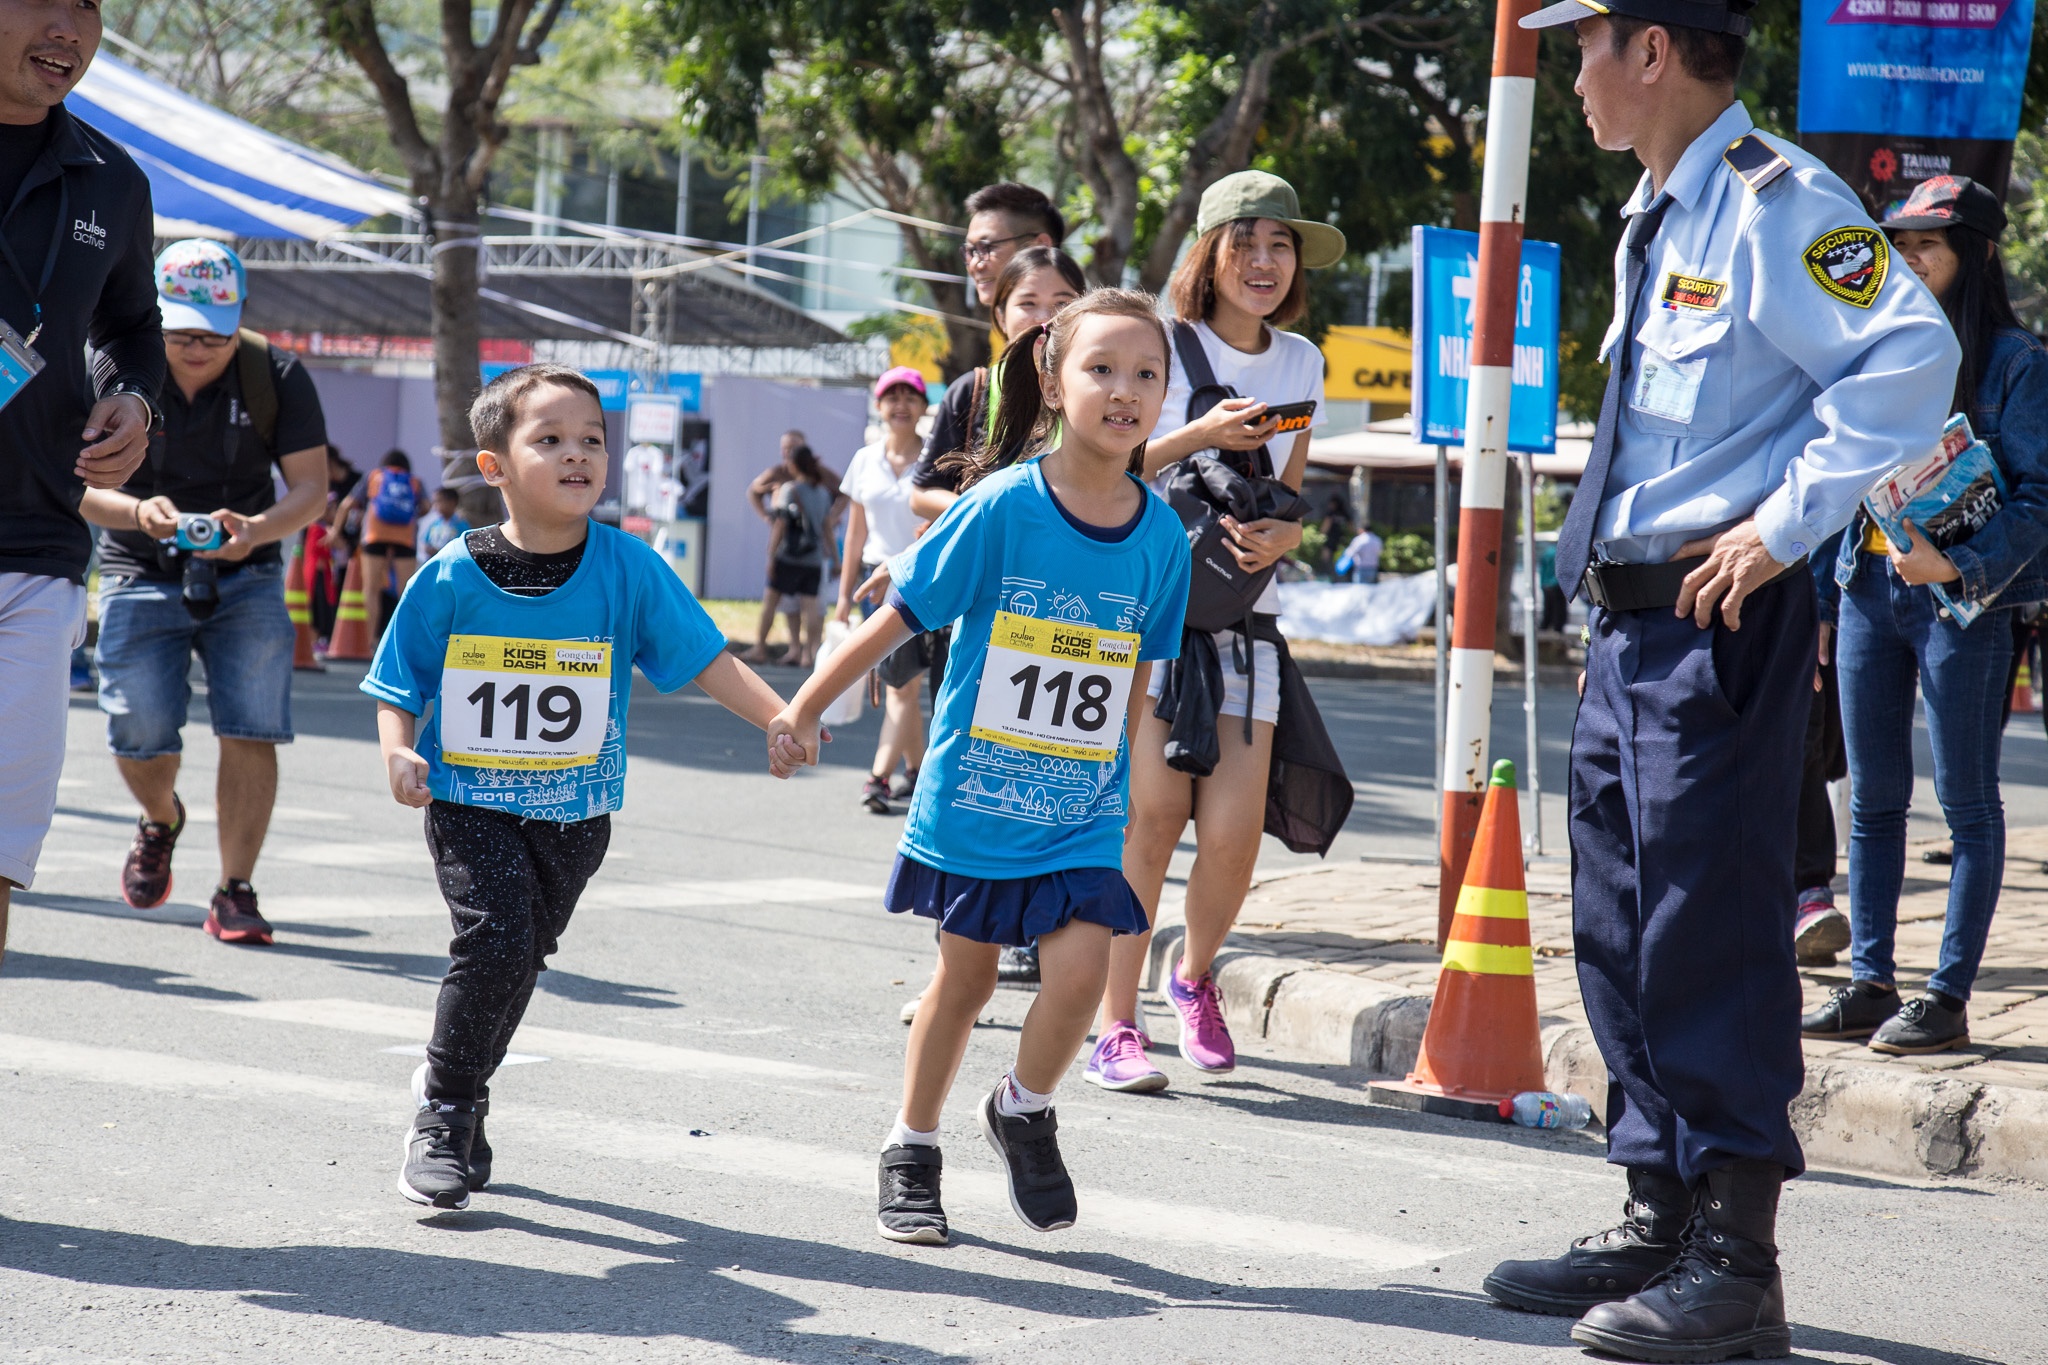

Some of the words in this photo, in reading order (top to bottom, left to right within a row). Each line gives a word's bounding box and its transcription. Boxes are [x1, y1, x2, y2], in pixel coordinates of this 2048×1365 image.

[1967, 4, 1997, 21] 5KM
[1901, 153, 1951, 170] TAIWAN
[74, 210, 106, 238] pulse
[73, 230, 105, 250] active
[1811, 231, 1874, 260] SECURITY
[1677, 278, 1721, 296] SECURITY
[1962, 486, 1997, 526] CITY
[1972, 502, 2002, 533] THE
[1936, 519, 1960, 538] 2018
[1010, 626, 1035, 642] pulse
[1053, 634, 1092, 649] KIDS
[462, 643, 486, 659] pulse
[1009, 638, 1034, 649] active
[503, 648, 547, 660] KIDS
[1050, 645, 1090, 659] DASH
[1098, 650, 1129, 663] 1KM
[461, 659, 486, 667] active
[503, 659, 547, 670] DASH
[557, 661, 598, 673] 1KM
[1009, 664, 1112, 732] 118
[467, 681, 582, 743] 119
[472, 792, 516, 803] 2018
[439, 1104, 456, 1112] NIKE
